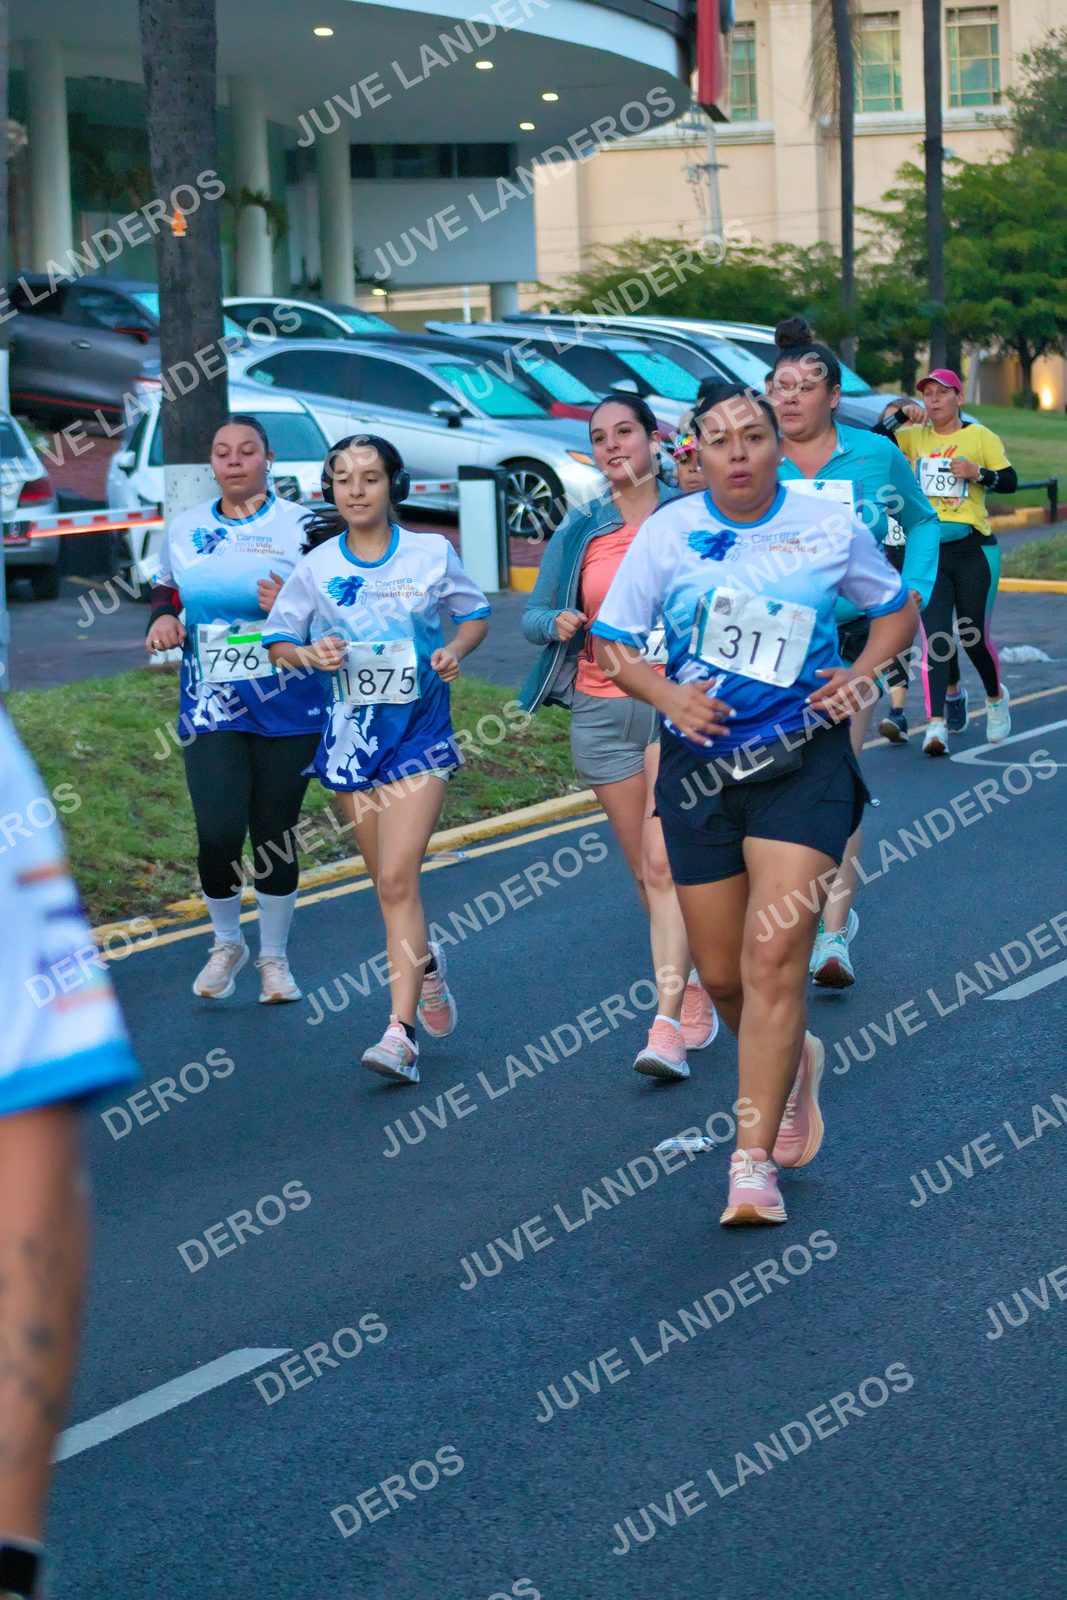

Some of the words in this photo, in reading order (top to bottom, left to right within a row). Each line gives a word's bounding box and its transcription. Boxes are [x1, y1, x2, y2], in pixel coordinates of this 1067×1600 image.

[926, 474, 957, 491] 789
[236, 533, 273, 542] Carrera
[375, 577, 413, 587] Carrera
[206, 646, 260, 673] 796
[718, 625, 788, 672] 311
[342, 666, 416, 696] 1875
